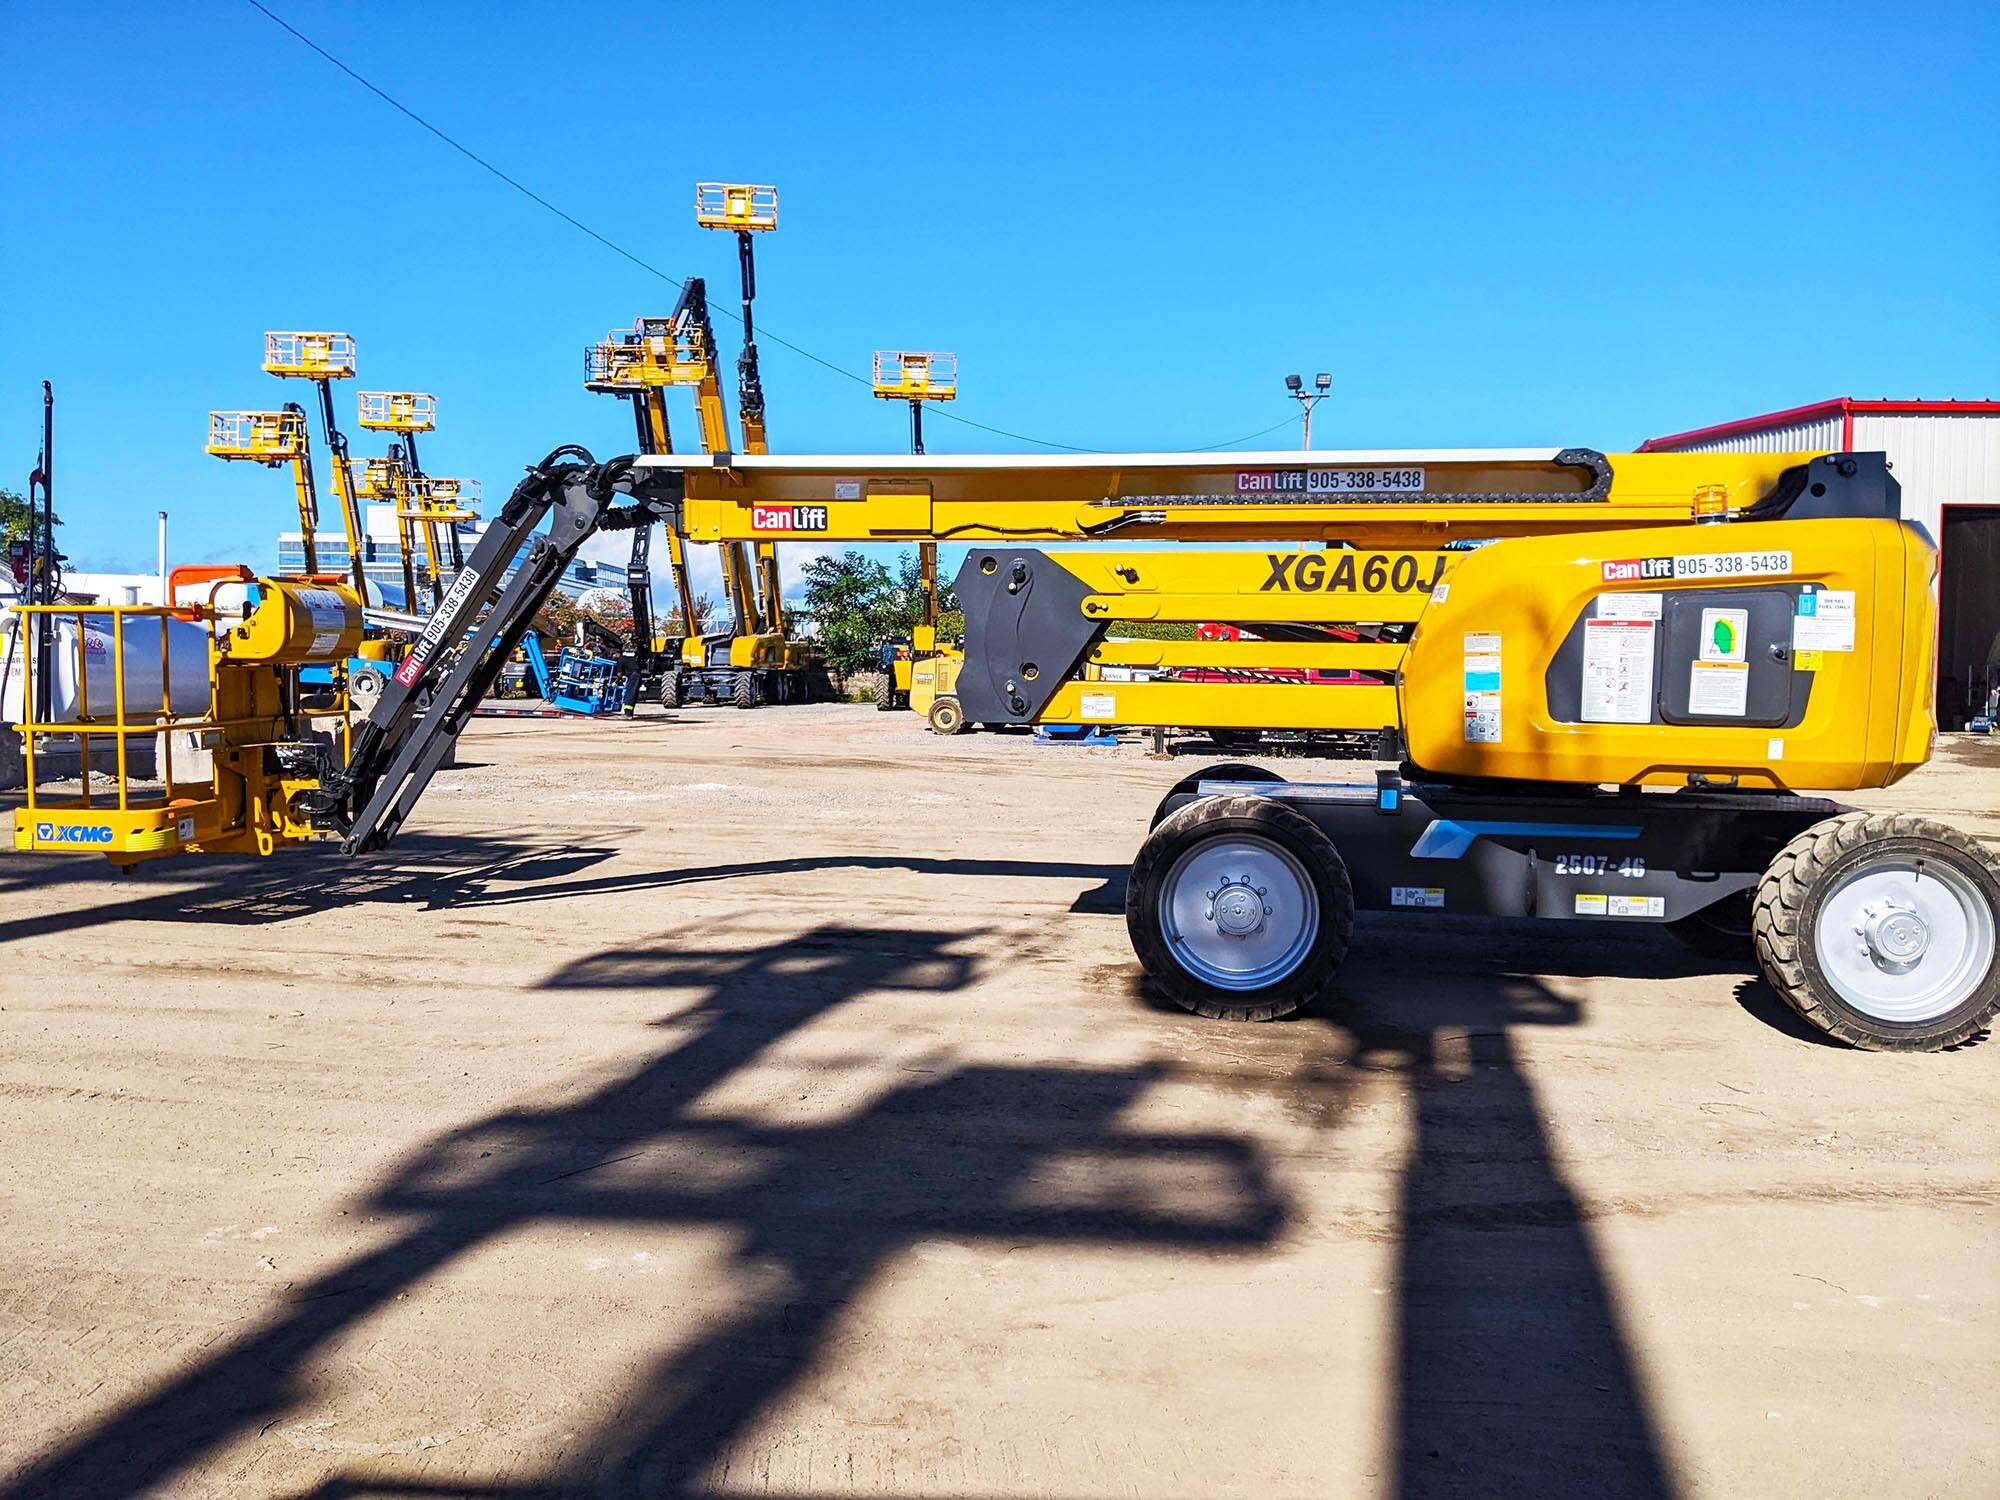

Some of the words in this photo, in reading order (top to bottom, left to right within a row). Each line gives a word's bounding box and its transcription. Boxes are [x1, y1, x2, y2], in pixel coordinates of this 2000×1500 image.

[1310, 471, 1421, 488] 905-338-5438
[1260, 555, 1448, 593] XGA60J
[1678, 554, 1788, 575] 905-338-5438
[427, 570, 476, 641] 905-338-5438
[55, 826, 113, 843] XCMG
[1555, 855, 1646, 877] 2507-46
